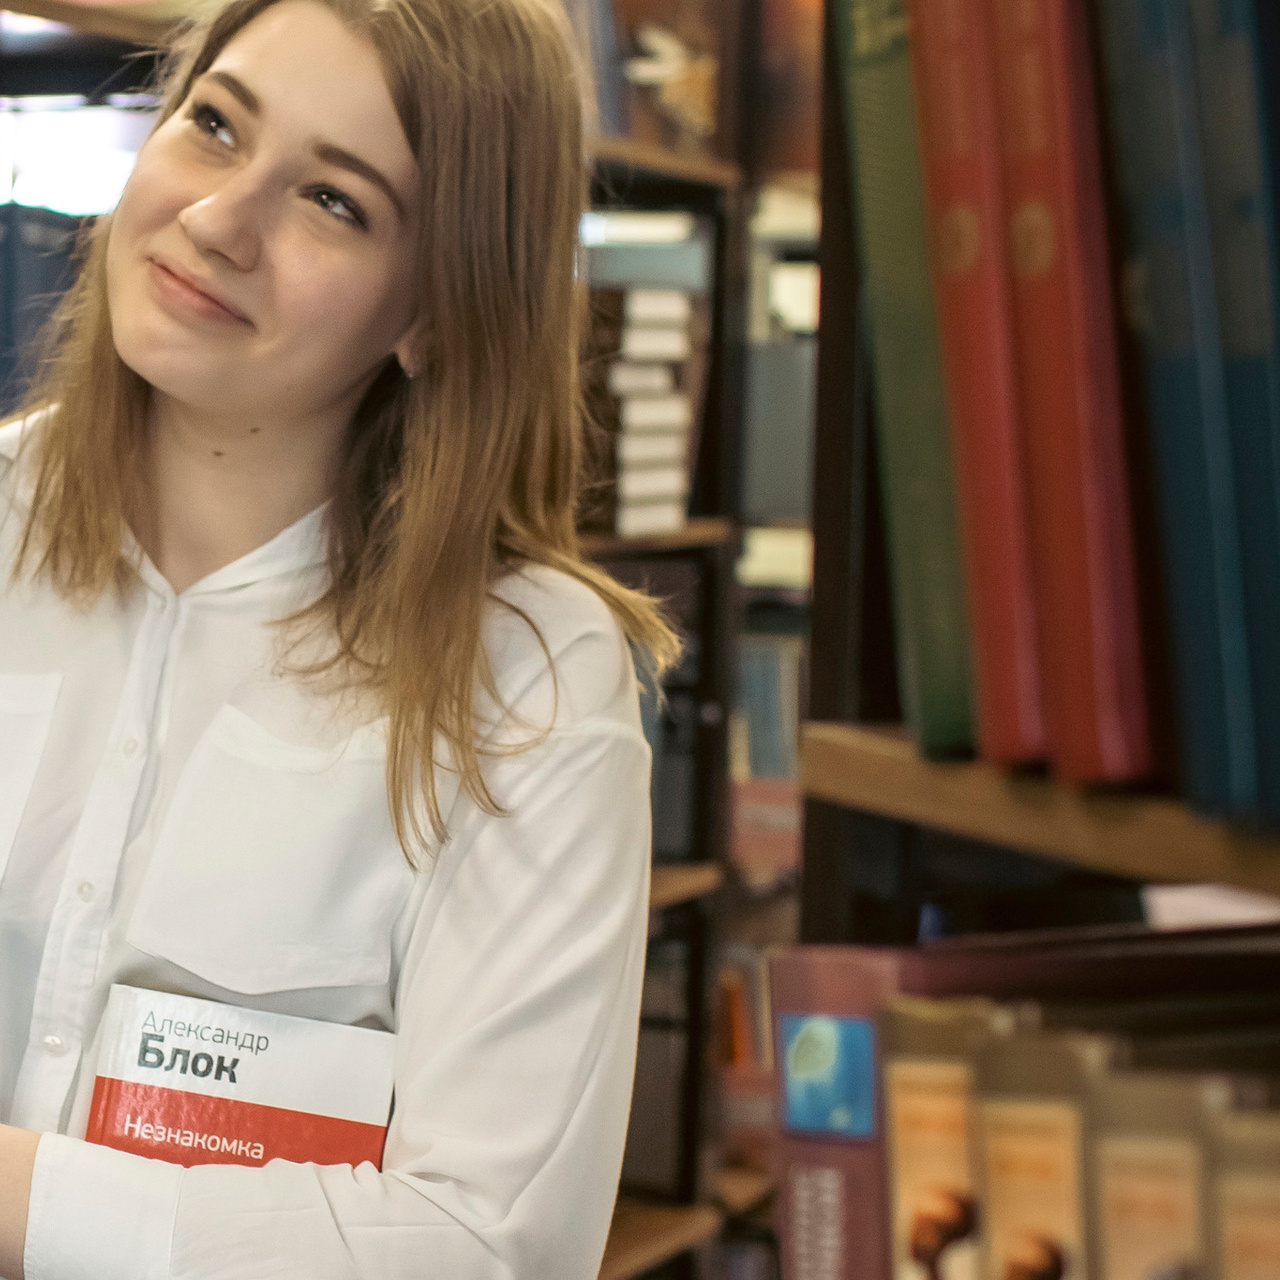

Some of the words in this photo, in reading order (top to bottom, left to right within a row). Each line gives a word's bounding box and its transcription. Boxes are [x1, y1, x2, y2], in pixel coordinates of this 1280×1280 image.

[141, 1010, 270, 1057] Александр
[136, 1031, 240, 1084] Блок
[122, 1114, 265, 1161] Незнакомка
